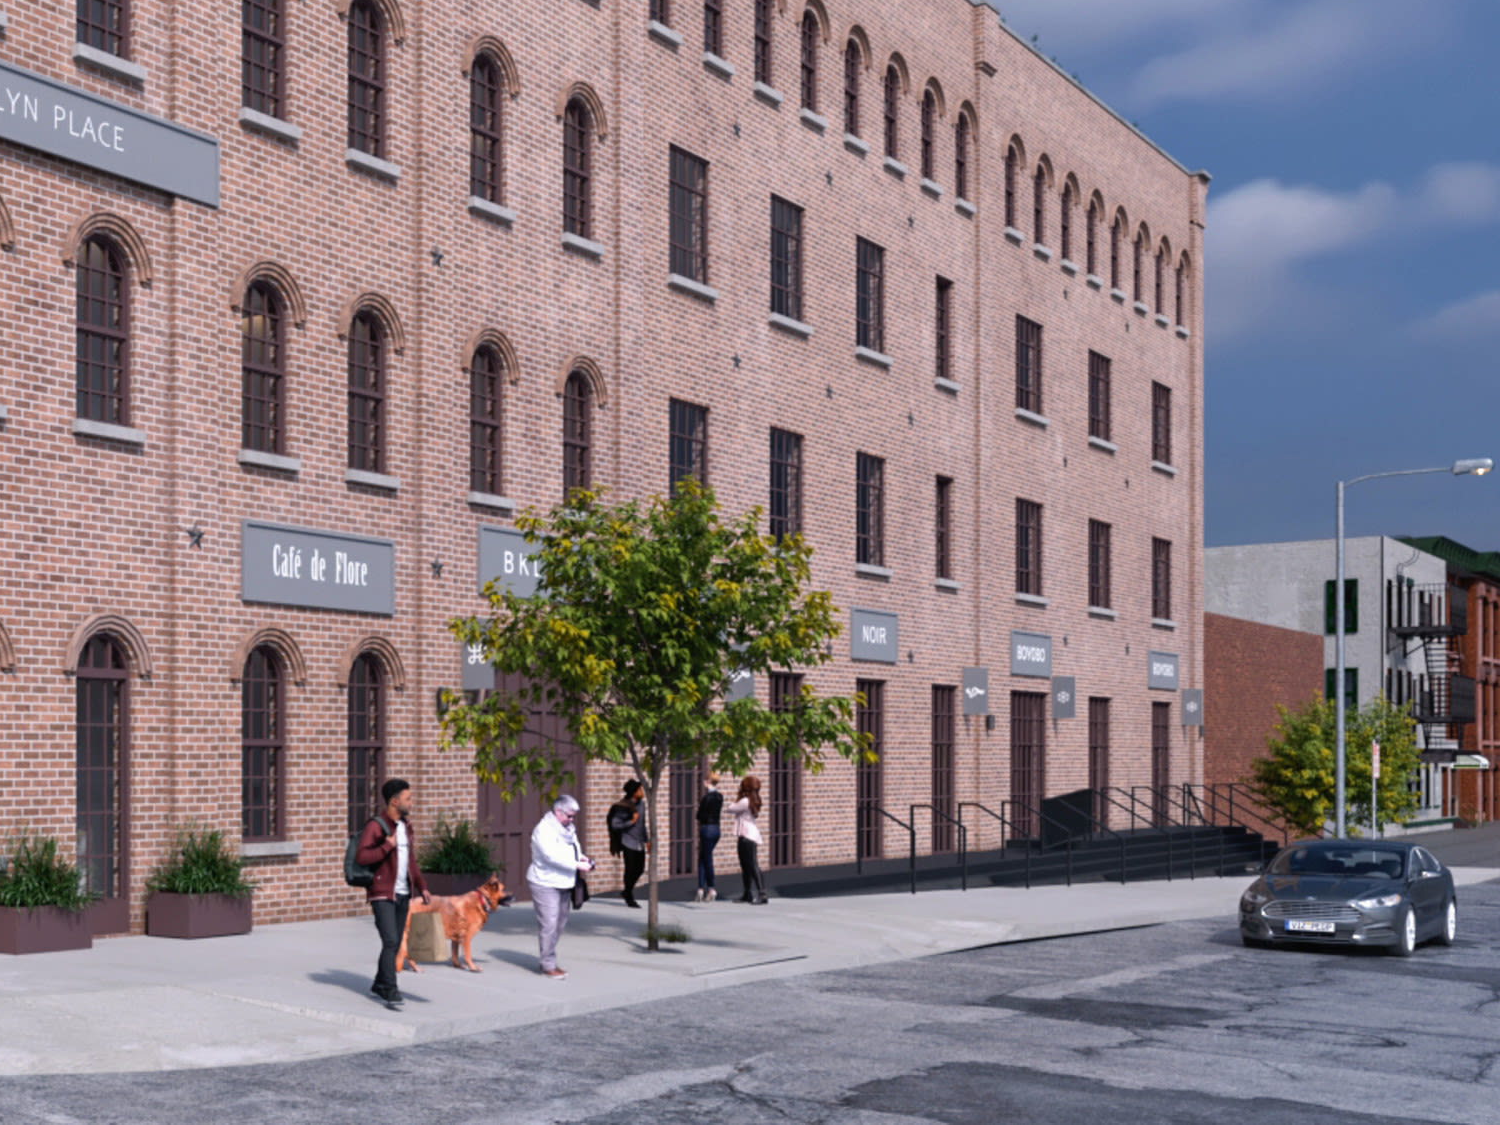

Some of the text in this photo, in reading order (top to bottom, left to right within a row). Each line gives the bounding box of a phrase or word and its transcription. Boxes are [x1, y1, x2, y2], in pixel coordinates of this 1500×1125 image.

[53, 104, 125, 153] PLACE
[272, 543, 369, 587] Café de Flore
[862, 624, 888, 645] NOIR
